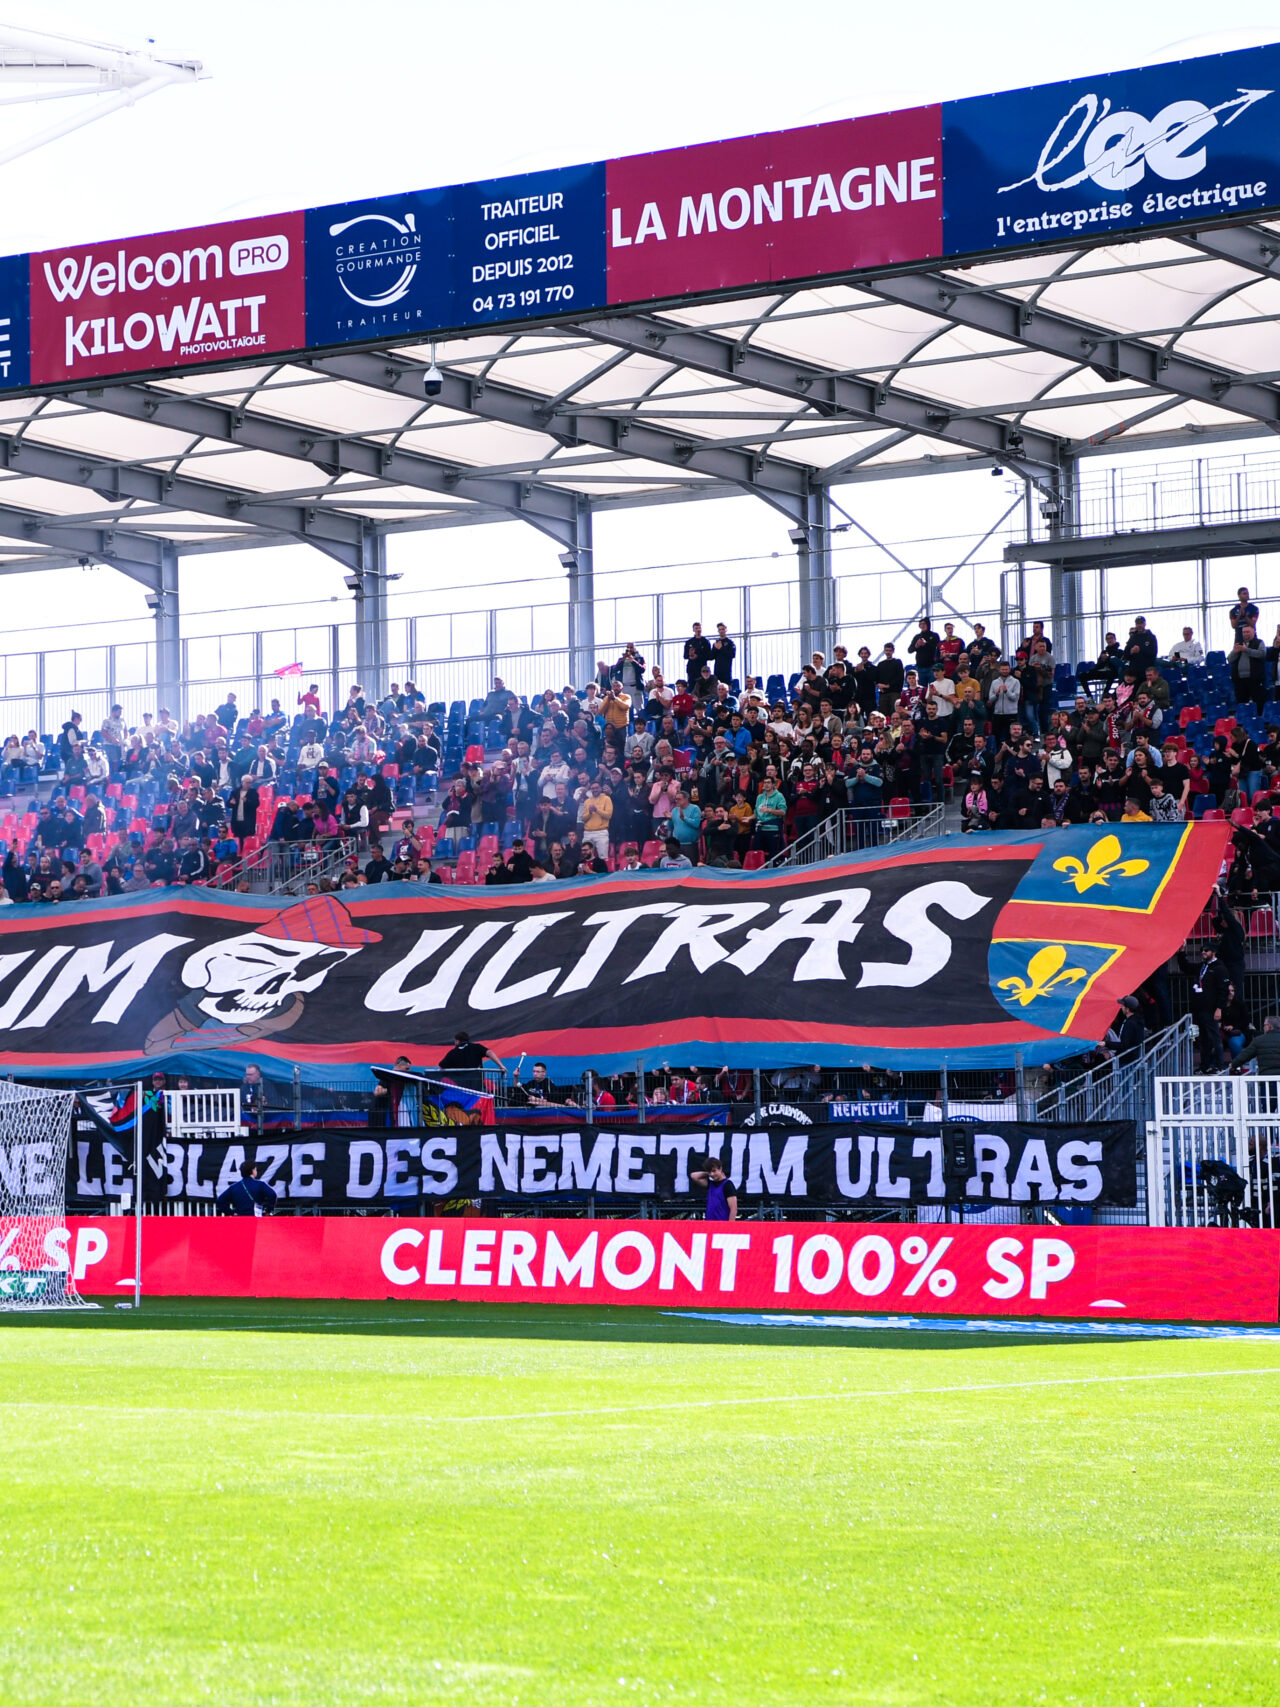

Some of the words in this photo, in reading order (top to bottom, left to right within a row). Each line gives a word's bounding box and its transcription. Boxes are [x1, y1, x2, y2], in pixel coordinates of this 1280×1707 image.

[481, 192, 564, 221] TRAITEUR
[612, 202, 667, 248] LA
[677, 156, 937, 238] MONTAGNE
[997, 201, 1133, 236] l'entreprise
[1142, 181, 1267, 213] électrique
[336, 234, 422, 257] CREATION
[484, 224, 560, 251] OFFICIEL
[43, 244, 223, 303] Welcom
[237, 243, 282, 268] PRO
[336, 252, 422, 274] GOURMANDE
[472, 257, 533, 283] DEPUIS
[536, 254, 574, 274] 2012
[472, 297, 494, 313] 04
[497, 293, 516, 310] 73
[519, 288, 541, 306] 191
[545, 284, 575, 303] 770
[65, 296, 266, 366] KILOWATT
[337, 310, 423, 330] TRAITEUR
[180, 334, 266, 356] PHOTOVOLTAÏQUE
[365, 880, 992, 1016] ULTRAS
[833, 1101, 899, 1116] NEMETUM
[77, 1141, 133, 1196] LE
[166, 1142, 326, 1199] BLAZE
[346, 1137, 458, 1199] DES
[479, 1132, 809, 1196] NEMETUM
[834, 1133, 1104, 1202] ULTRAS
[41, 1227, 109, 1280] SP
[380, 1228, 750, 1292] CLERMONT
[772, 1233, 957, 1298] 100%
[982, 1237, 1075, 1299] SP
